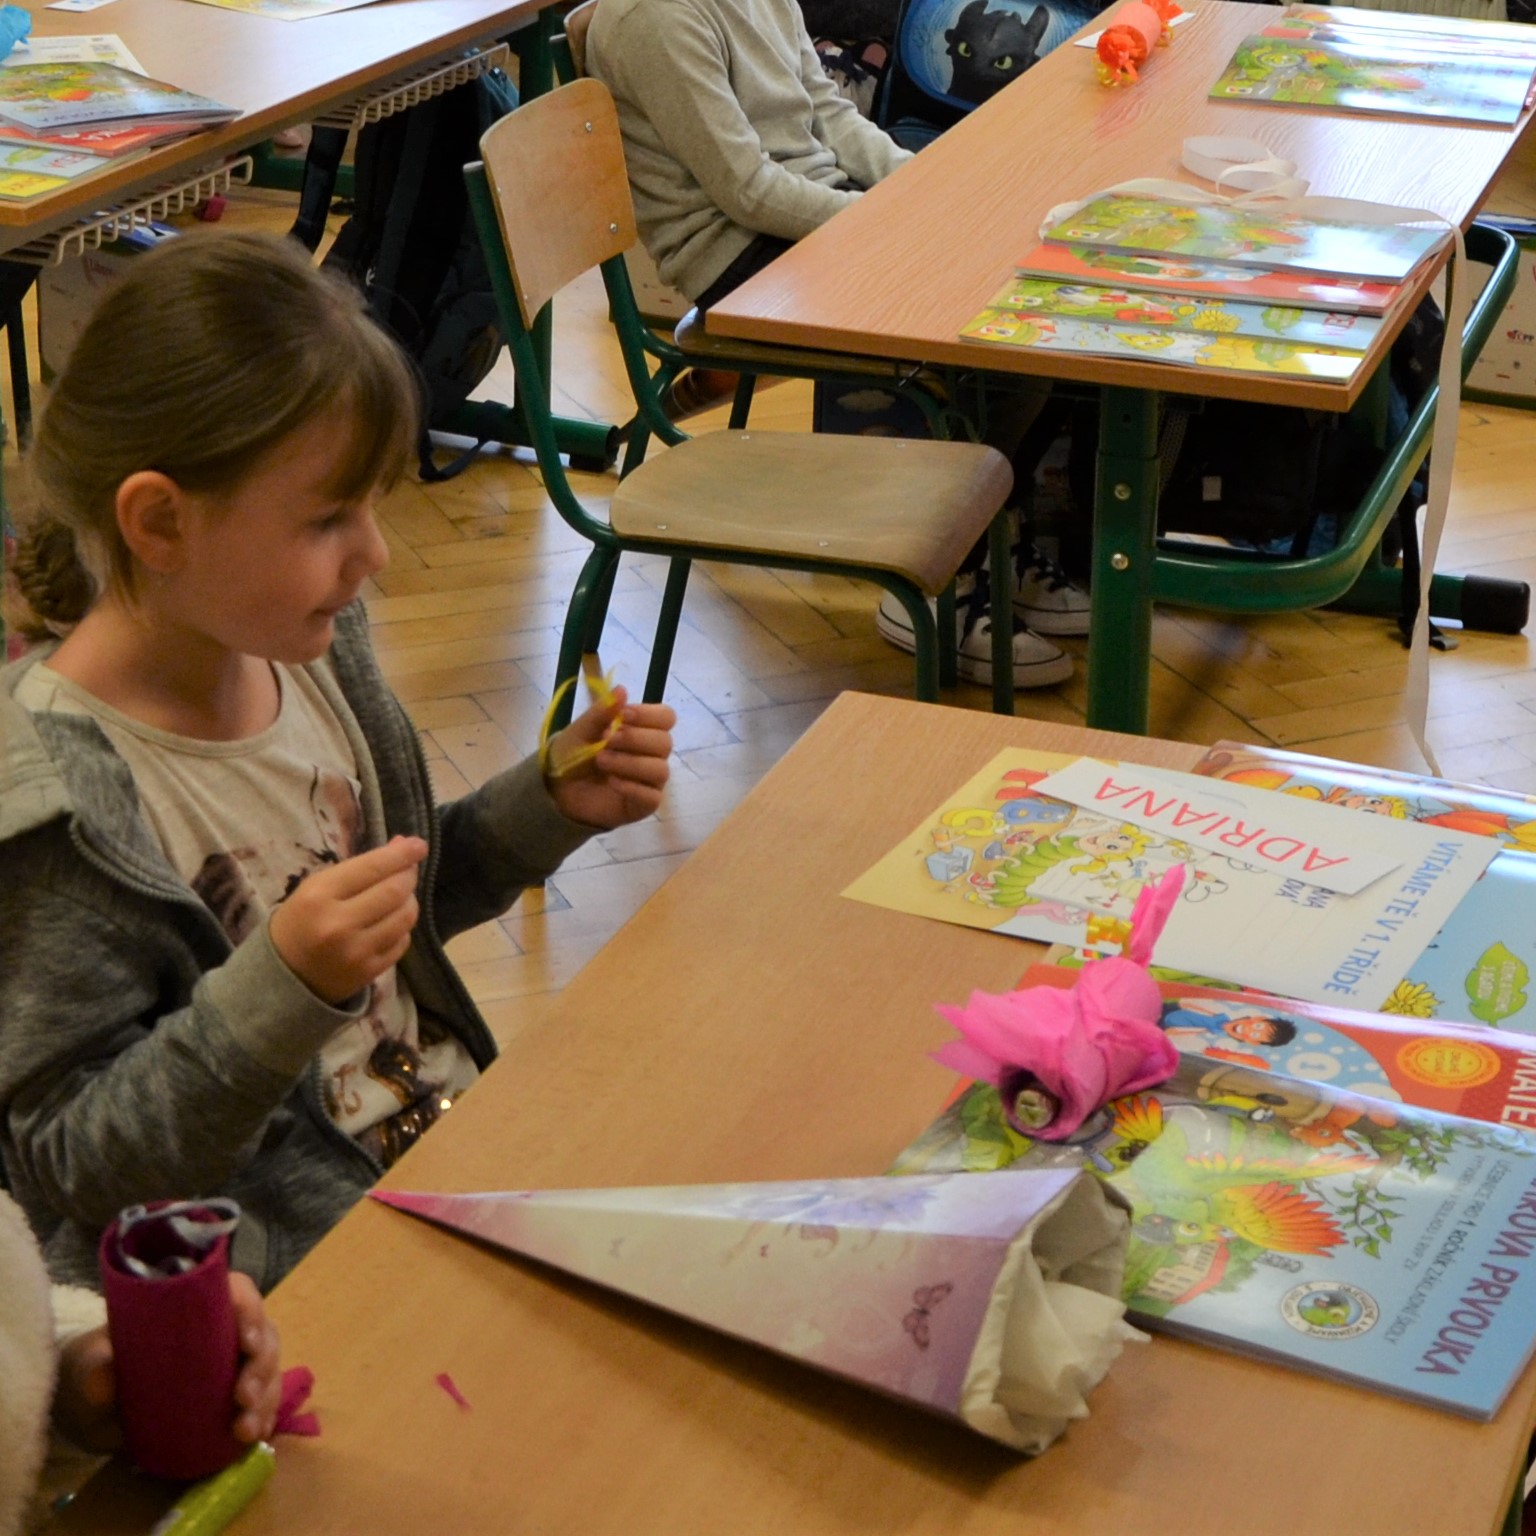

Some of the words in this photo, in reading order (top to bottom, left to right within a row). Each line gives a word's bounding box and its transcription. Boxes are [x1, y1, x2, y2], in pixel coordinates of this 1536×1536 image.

[1094, 777, 1349, 872] ADRIANA
[1401, 841, 1463, 897] VÍTÁME
[1376, 918, 1404, 932] V
[1384, 898, 1420, 918] TĚ
[1361, 933, 1390, 944] 1.
[1322, 948, 1381, 996] TŘÍDĚ
[1458, 1219, 1477, 1228] 1.
[1433, 1228, 1469, 1267] ROČNÍK
[1402, 1266, 1443, 1319] ZÁKLADNÍ
[1416, 1262, 1520, 1375] PRVOUKA
